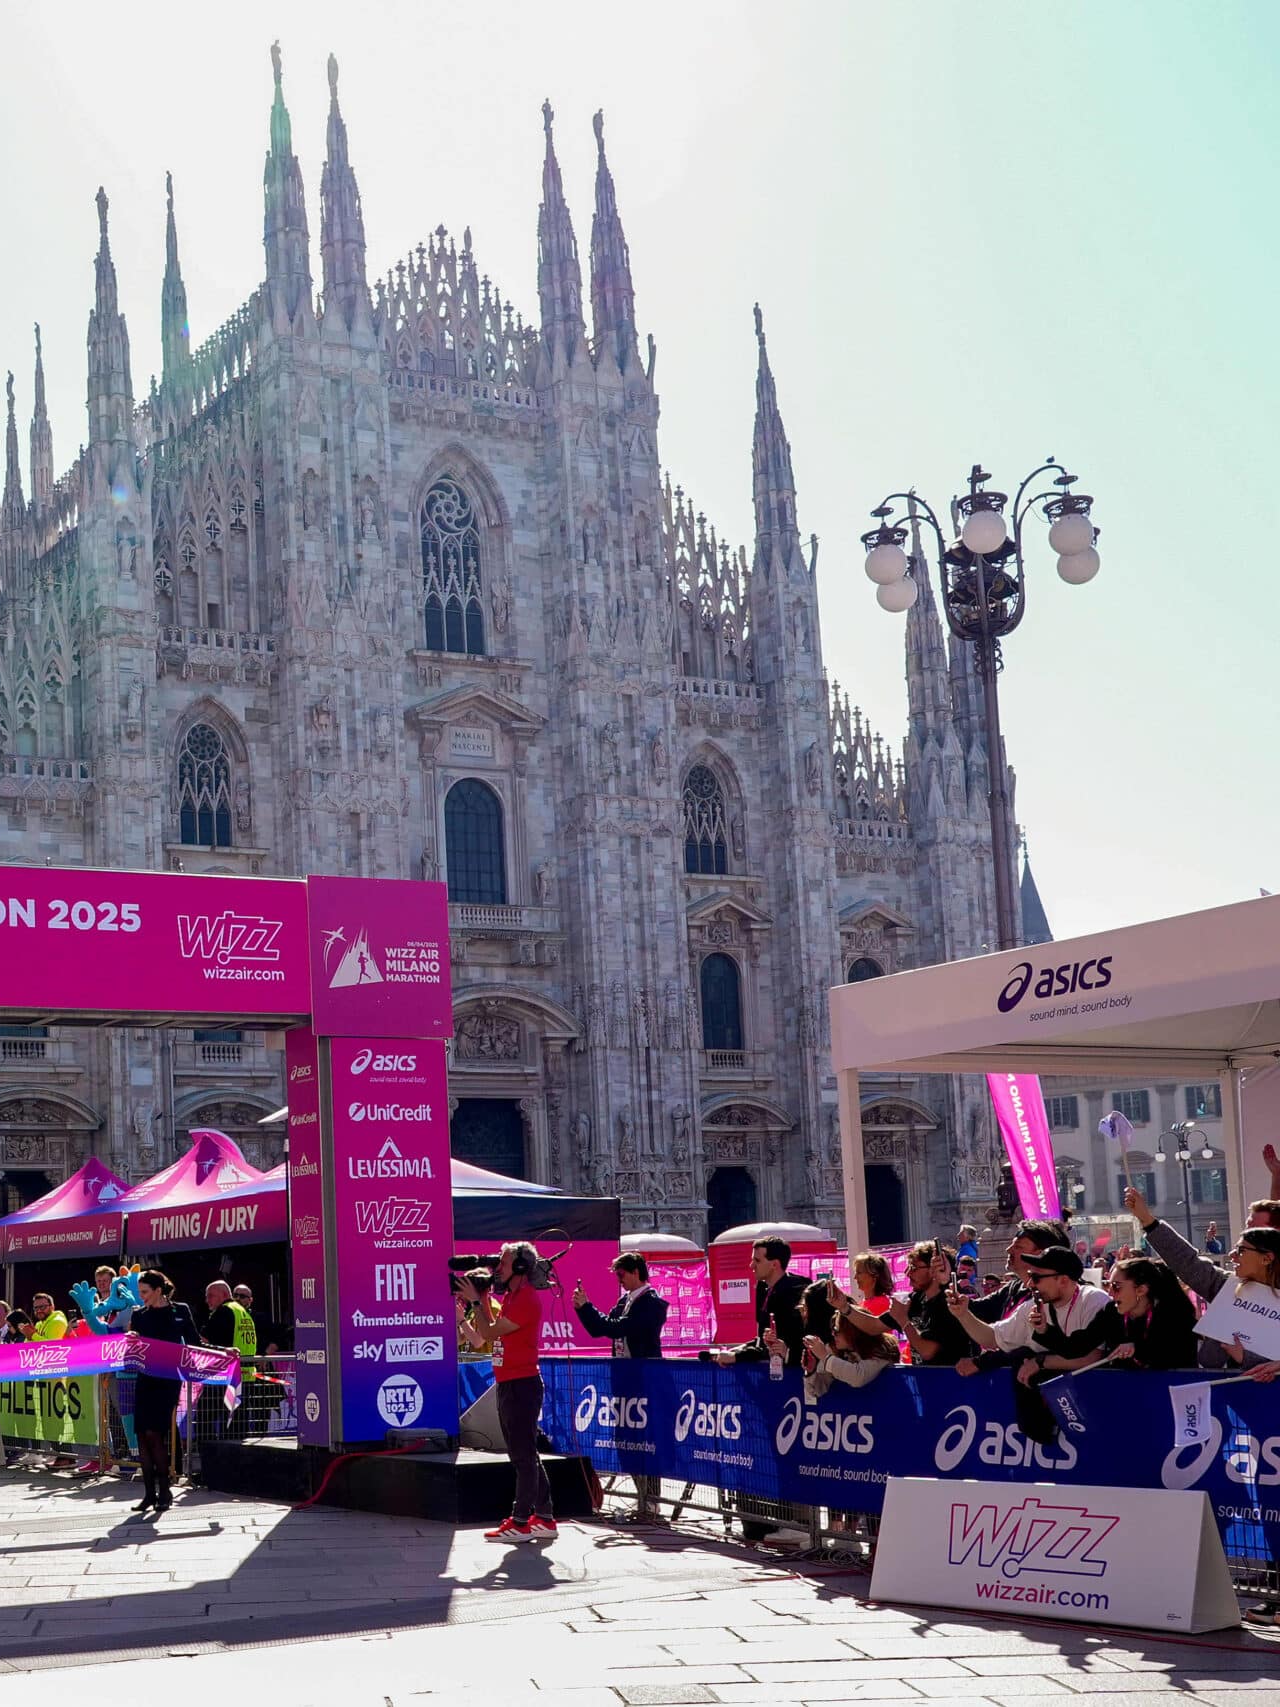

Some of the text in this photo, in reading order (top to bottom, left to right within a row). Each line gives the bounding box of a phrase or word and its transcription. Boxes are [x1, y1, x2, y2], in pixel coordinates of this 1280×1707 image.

[47, 898, 141, 933] 2025
[385, 947, 439, 960] WIZZ AIR
[202, 967, 285, 983] wizzair.com
[385, 959, 440, 973] MILANO
[386, 973, 440, 984] MARATHON
[1029, 994, 1133, 1022] sound mind, sound body
[367, 1103, 432, 1121] UniCredit
[348, 1157, 433, 1179] LEVISSIMA
[150, 1212, 202, 1241] TIMING
[216, 1204, 260, 1234] JURY
[374, 1238, 433, 1249] wizzair.com
[302, 1278, 316, 1299] FIAT
[375, 1263, 417, 1301] FIAT
[1233, 1298, 1252, 1310] DAI
[1250, 1304, 1270, 1317] DAI
[541, 1321, 575, 1338] AIR
[352, 1340, 419, 1362] sky wifi
[385, 1388, 416, 1403] RTL
[386, 1402, 416, 1413] 102.5
[799, 1464, 820, 1477] sound
[843, 1469, 870, 1482] sound
[871, 1469, 889, 1484] bod
[1218, 1504, 1263, 1520] sound
[976, 1578, 1110, 1611] wizzair.com
